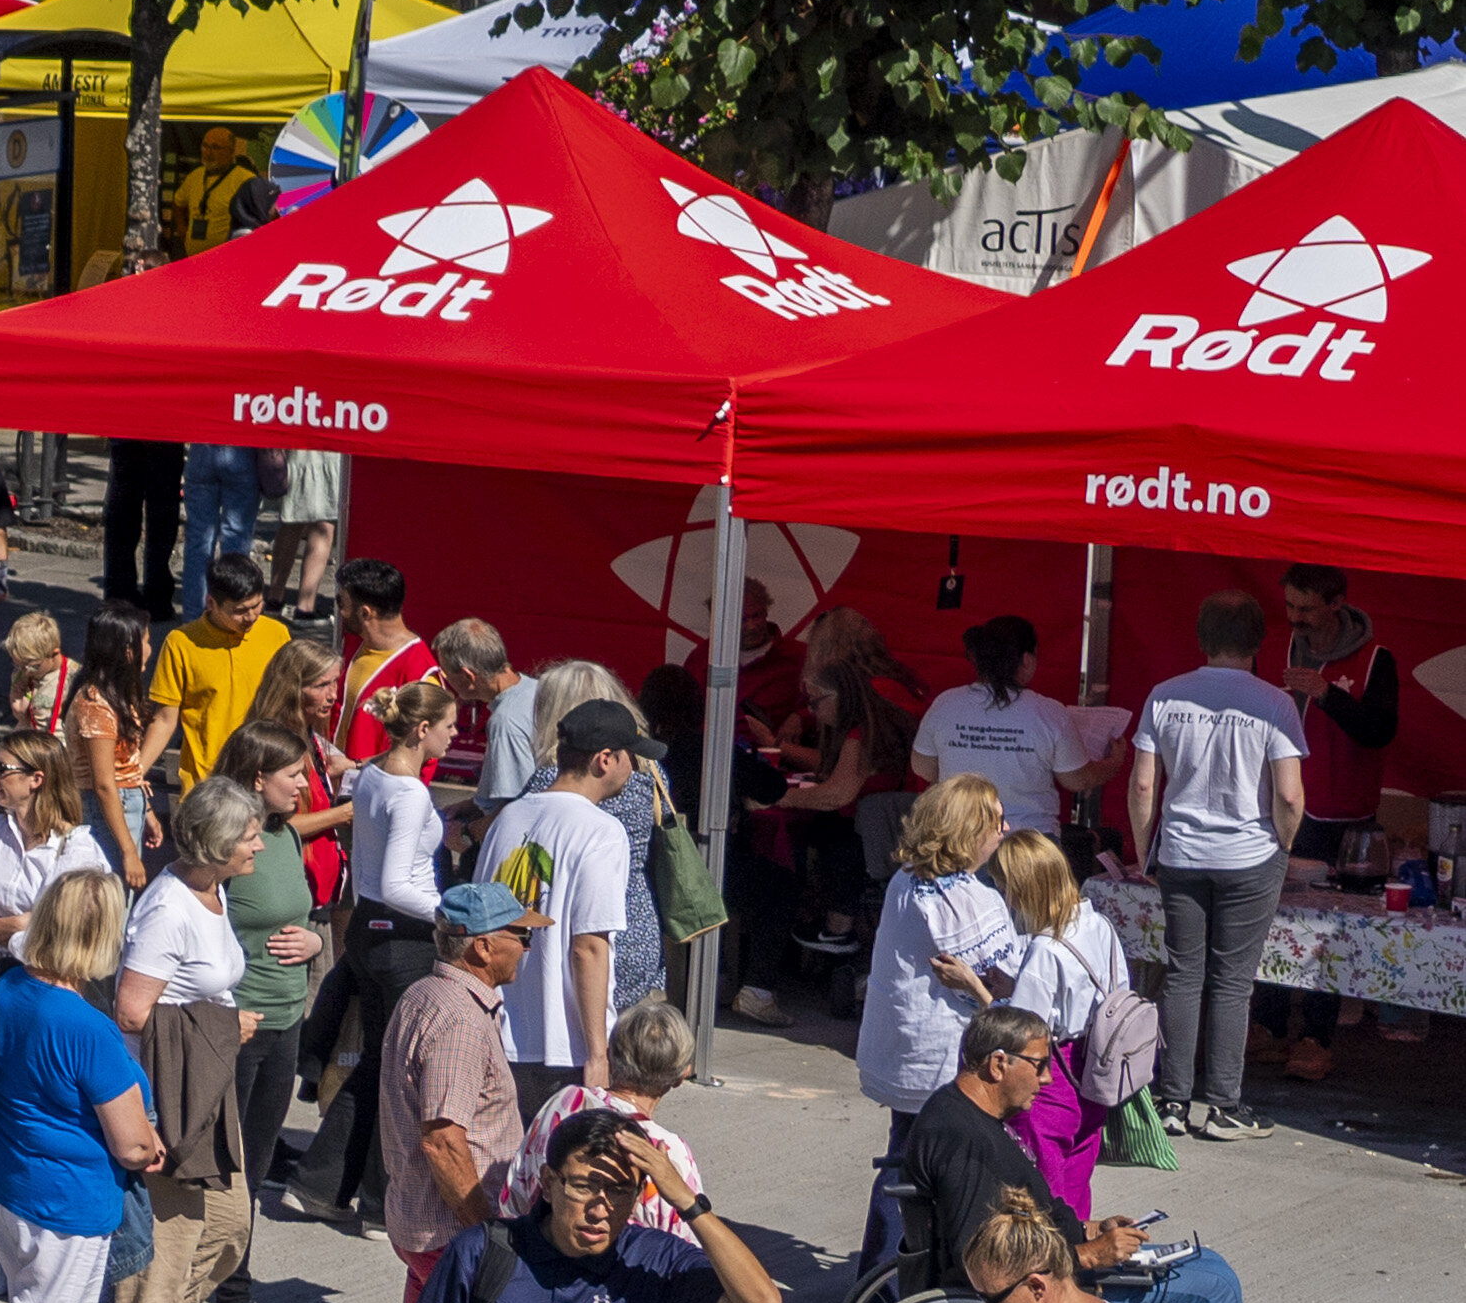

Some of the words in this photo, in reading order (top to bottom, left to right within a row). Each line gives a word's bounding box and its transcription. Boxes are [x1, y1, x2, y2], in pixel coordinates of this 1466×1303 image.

[262, 263, 494, 322] Rødt
[720, 263, 892, 322] Rødt
[1105, 313, 1376, 382] Rødt
[232, 385, 389, 433] rødt.no
[1085, 466, 1272, 520] rødt.no
[1167, 712, 1194, 725] FREE
[1199, 713, 1255, 729] PALESTINA
